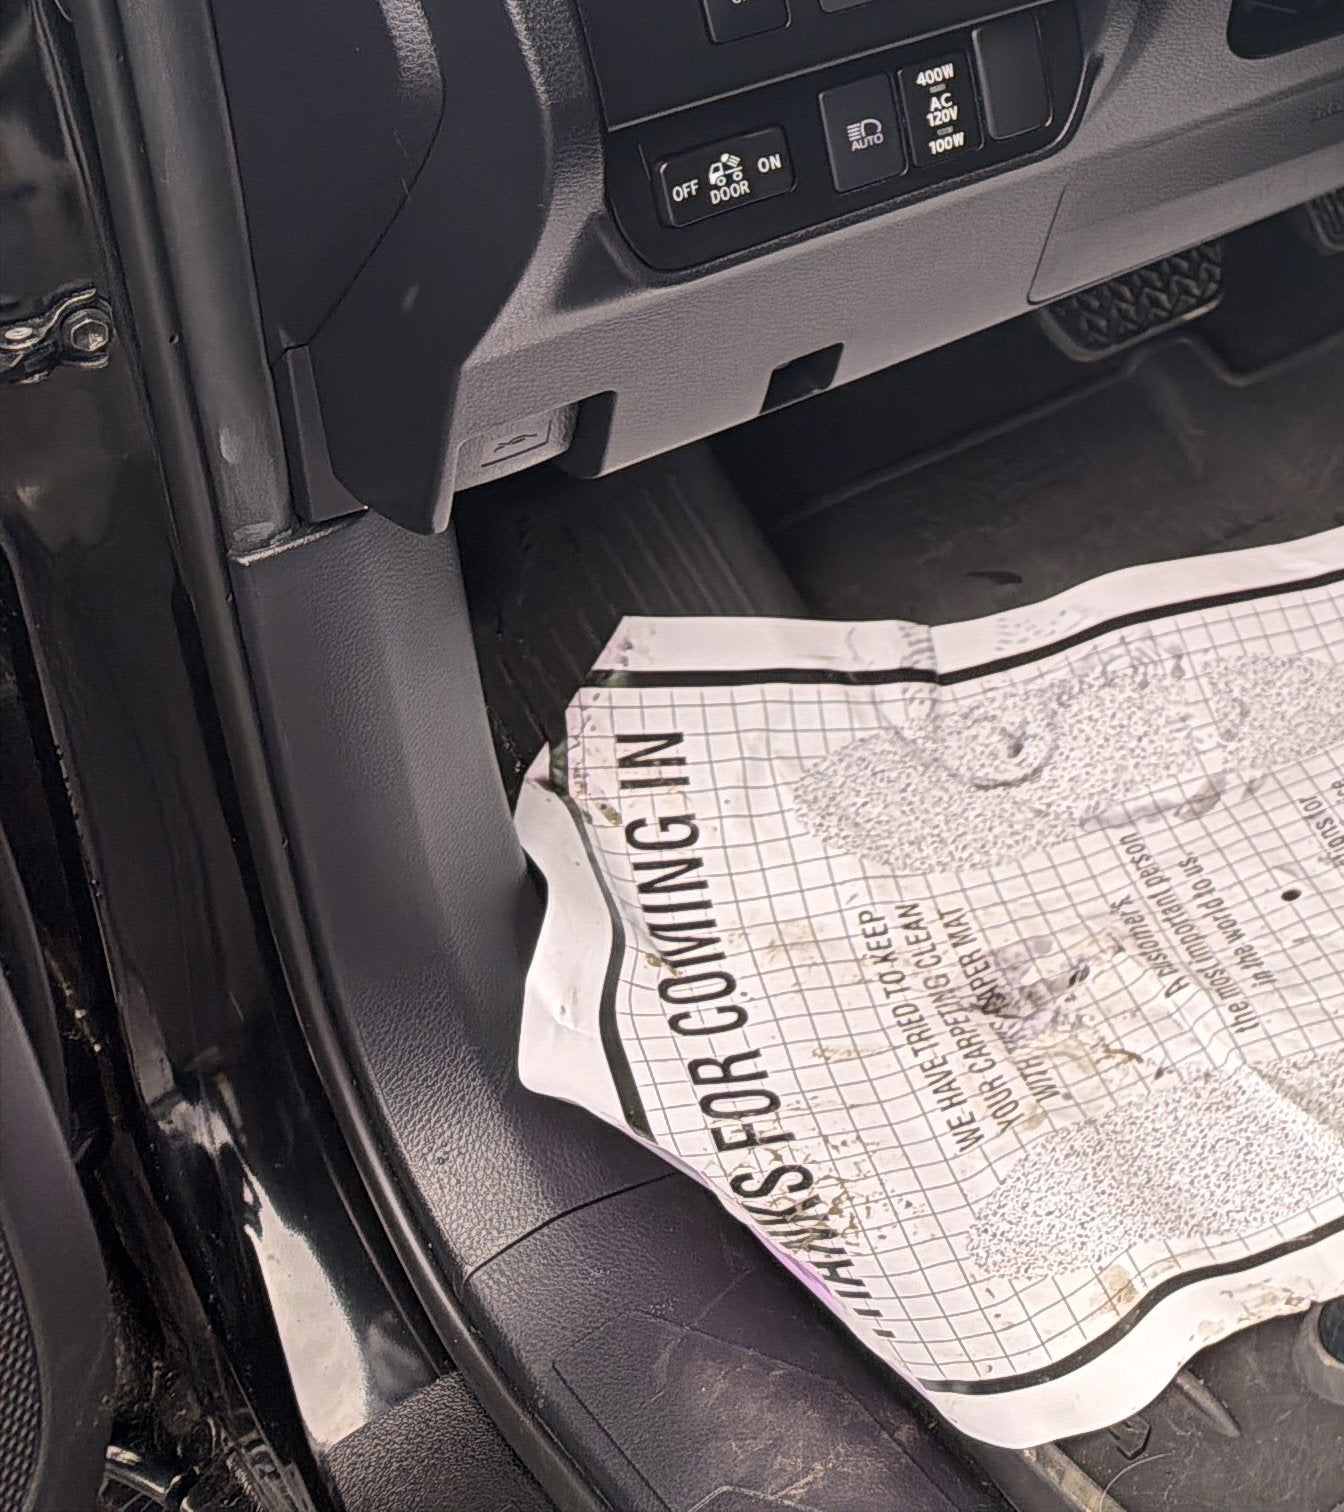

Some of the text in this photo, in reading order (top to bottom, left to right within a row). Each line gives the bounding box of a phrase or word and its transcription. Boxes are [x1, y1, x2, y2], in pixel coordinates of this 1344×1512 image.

[916, 63, 955, 87] 400W
[930, 93, 953, 110] AC
[926, 106, 958, 127] 120V
[851, 131, 884, 152] AUTO
[928, 132, 965, 155] 100W
[757, 153, 782, 175] ON
[672, 178, 699, 202] OFF
[710, 180, 750, 204] DOOR
[1298, 795, 1328, 820] for
[1192, 878, 1216, 900] to
[937, 907, 977, 948] MAT
[1119, 832, 1260, 1034] the most important person
[1197, 897, 1245, 945] world
[1120, 909, 1180, 978] customer
[1233, 944, 1265, 969] the
[1164, 975, 1192, 999] A
[1251, 969, 1278, 987] in
[858, 910, 985, 1152] WE HAVE TRIED TO KEEP
[895, 903, 1025, 1135] YOUR CARPETING CLEAN
[616, 731, 896, 1338] ANKS FOR COMING IN
[1014, 1054, 1060, 1104] WITH
